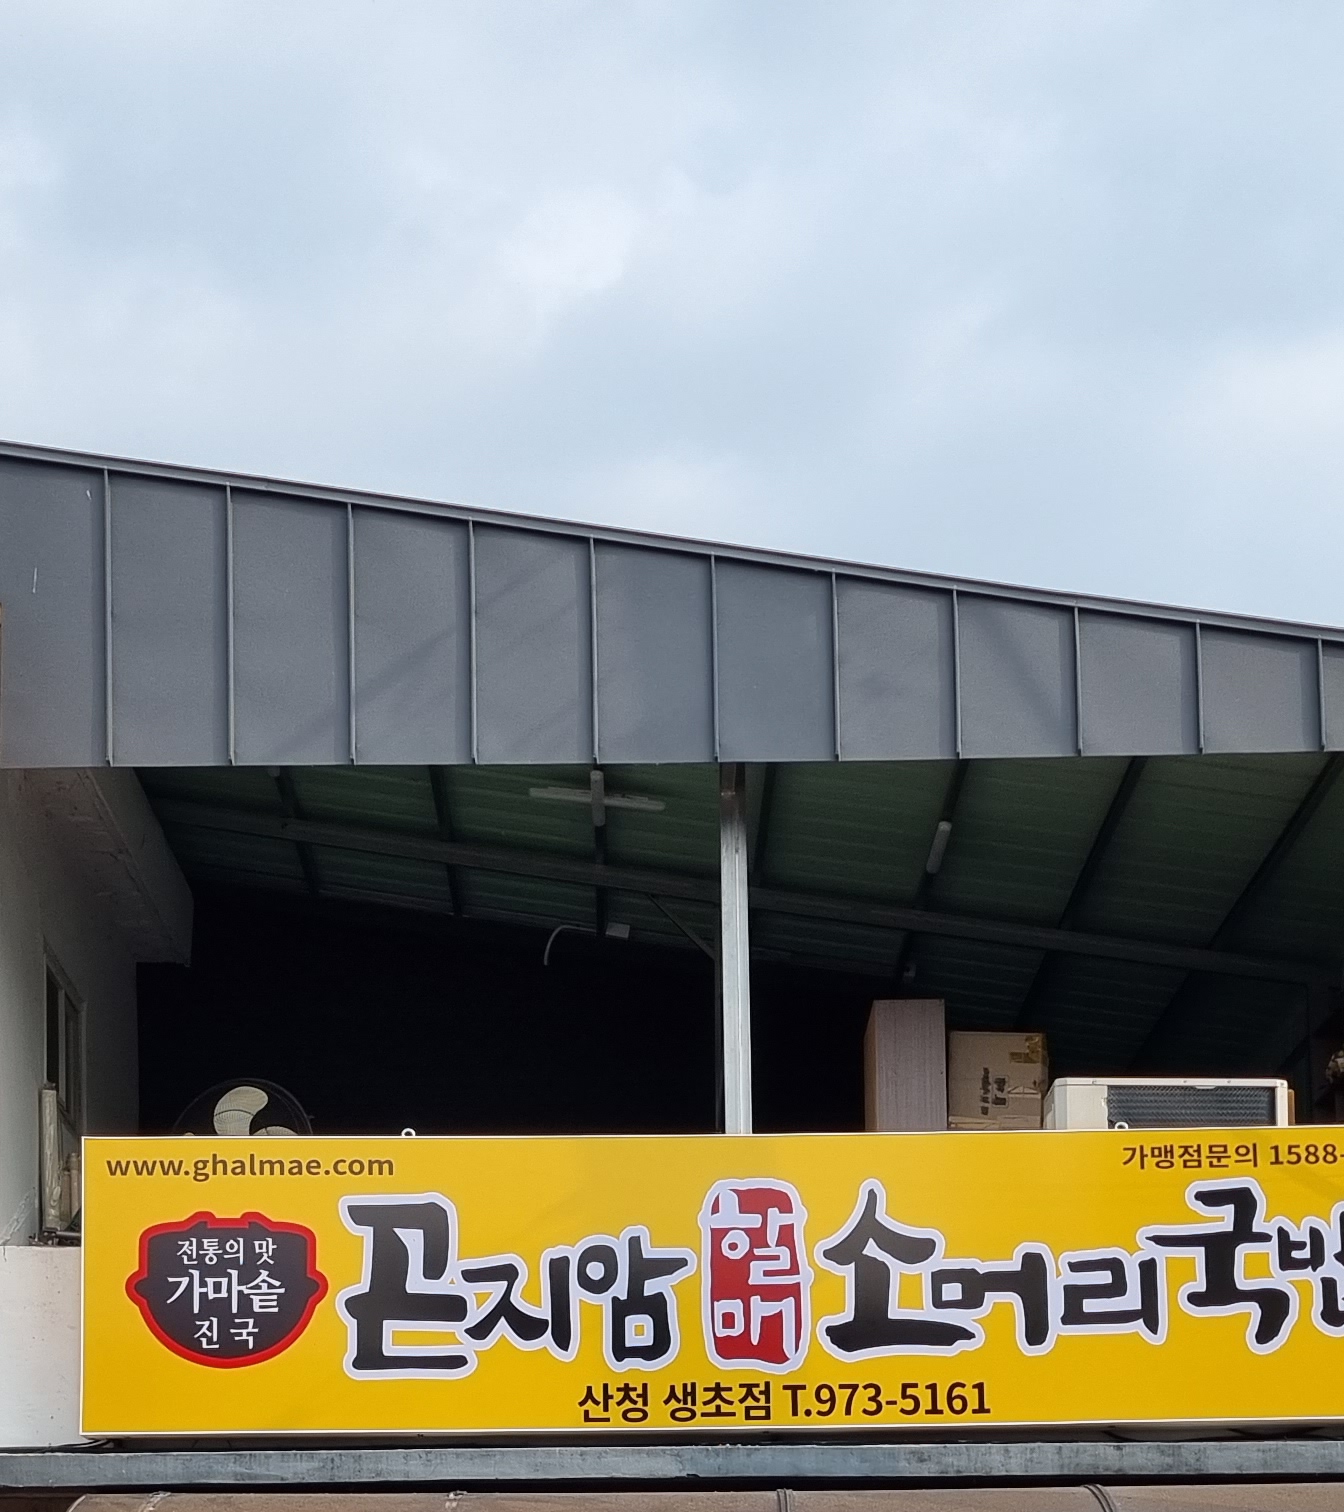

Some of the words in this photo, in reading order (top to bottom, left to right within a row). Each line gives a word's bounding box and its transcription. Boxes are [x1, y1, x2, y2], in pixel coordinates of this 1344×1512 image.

[106, 1152, 395, 1183] www.ghalmae.com
[1121, 1142, 1260, 1171] 가맹점문의
[175, 1237, 246, 1266] 전통의
[253, 1236, 278, 1266] 맛
[165, 1267, 287, 1315] 가마솥
[342, 1197, 691, 1372] 곤지암
[704, 1184, 804, 1364] 할매
[577, 1380, 650, 1424] 산청
[662, 1380, 773, 1422] 생초점
[781, 1380, 992, 1418] T.973-5161
